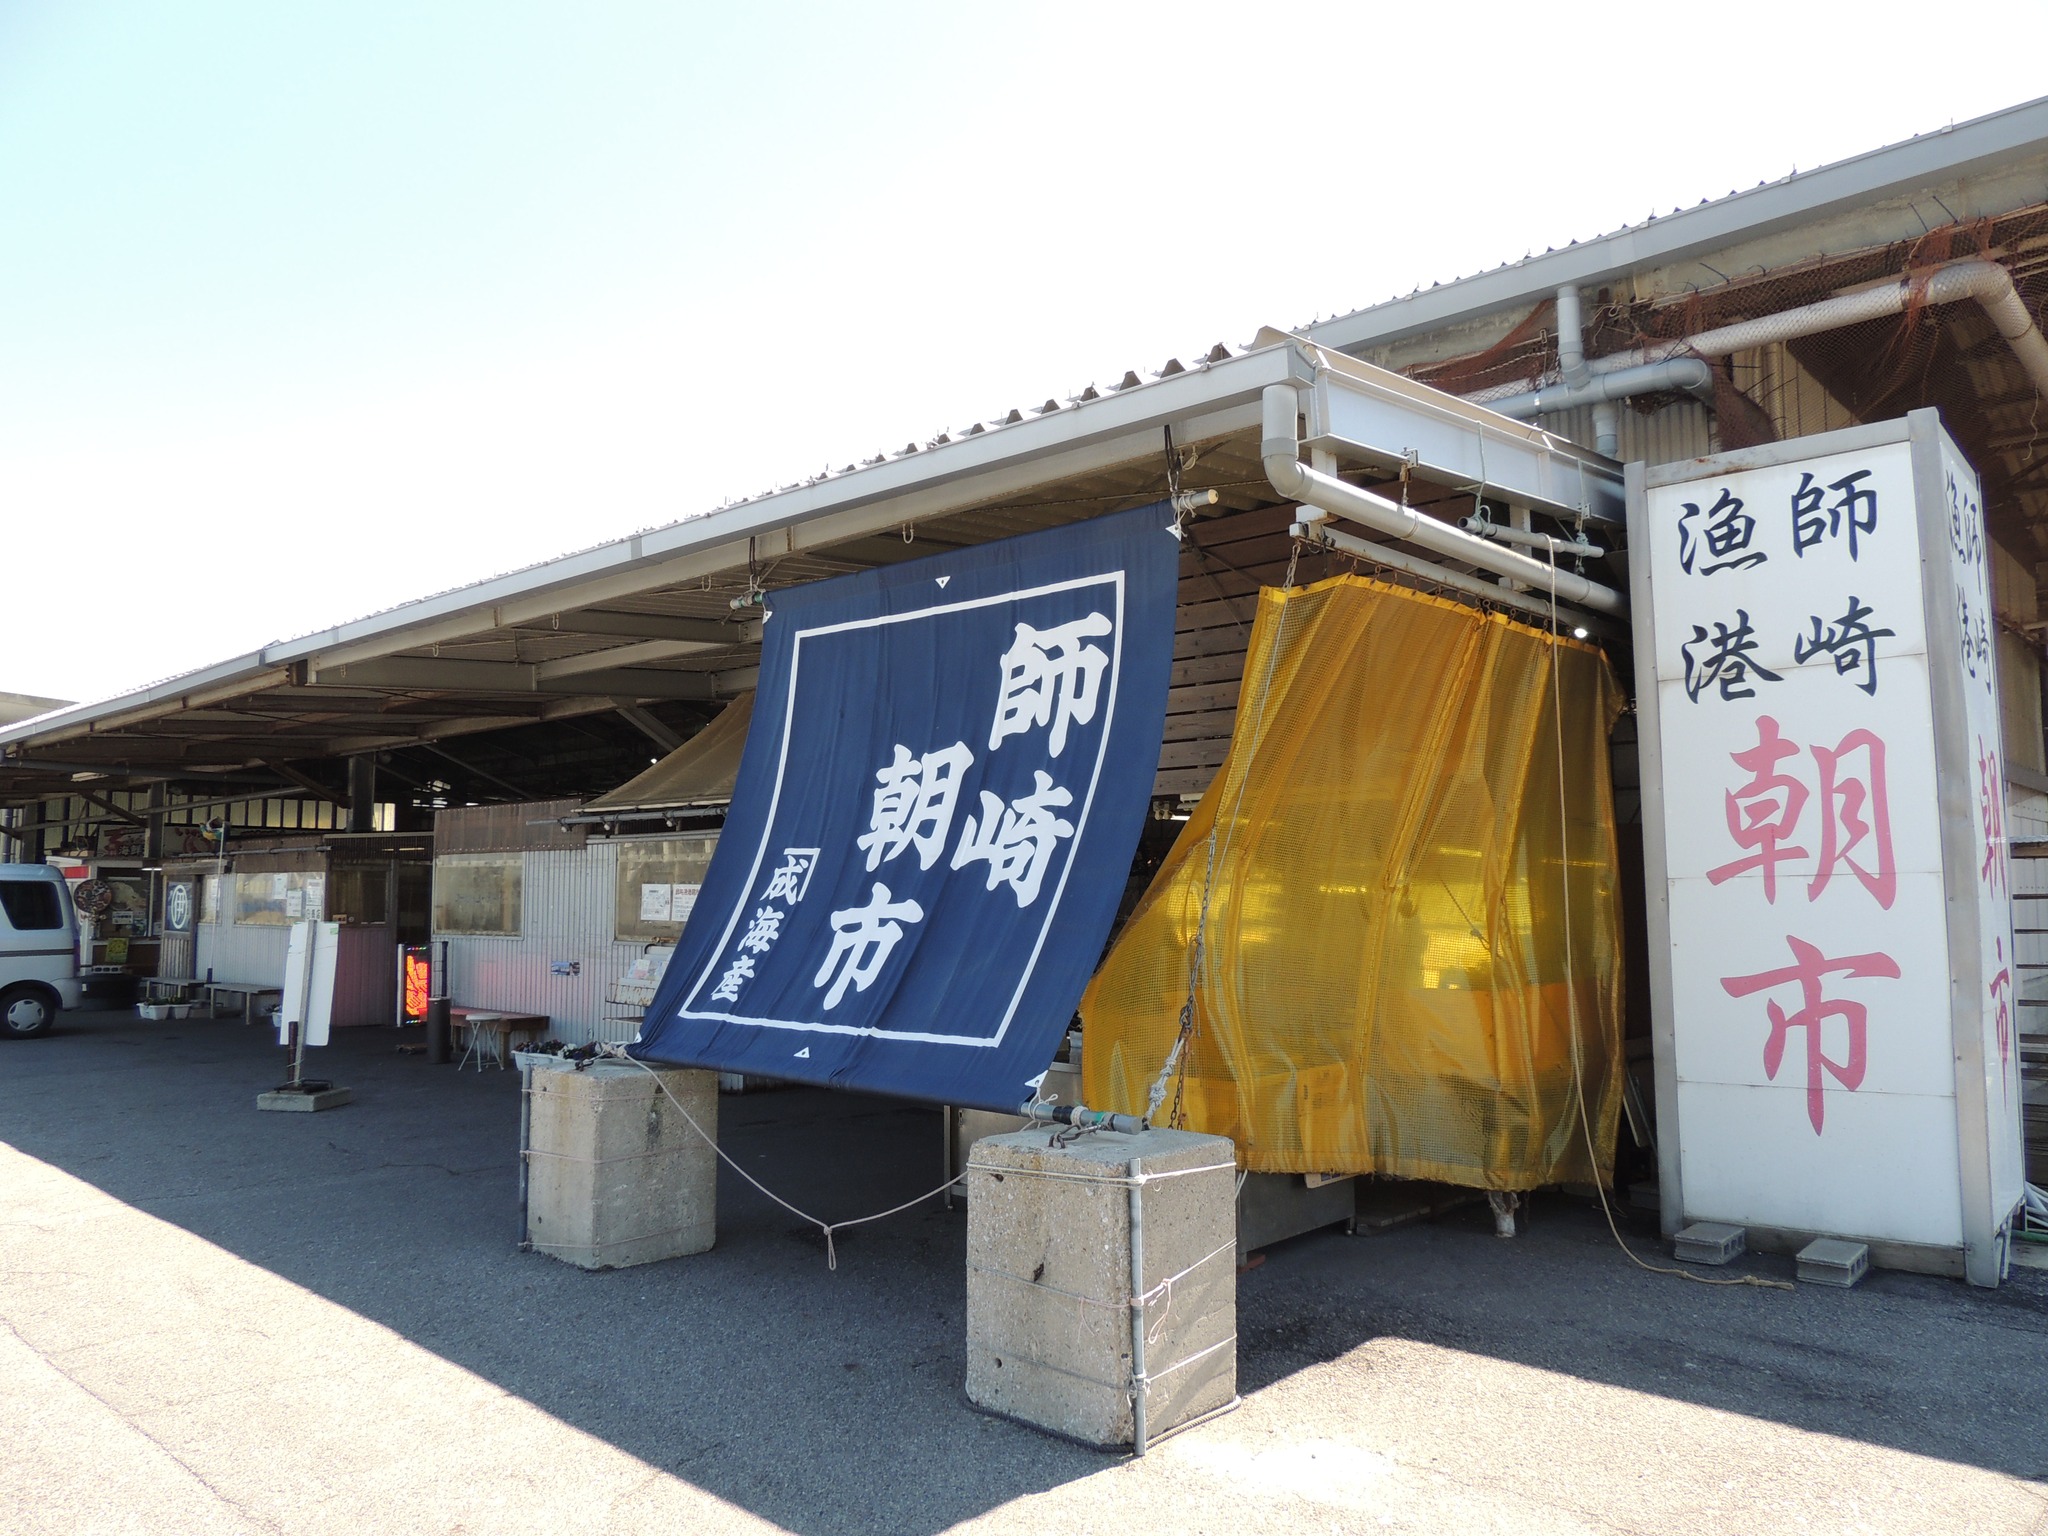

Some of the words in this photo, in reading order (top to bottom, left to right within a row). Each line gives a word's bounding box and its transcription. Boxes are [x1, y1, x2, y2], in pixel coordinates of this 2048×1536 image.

[1676, 487, 1785, 705] 漁港
[1793, 469, 1895, 698] 師崎
[813, 740, 974, 1011] 朝市
[951, 611, 1112, 908] 師崎
[711, 854, 810, 1002] 成海産
[1705, 714, 1901, 1138] 朝市
[1977, 733, 2010, 1112] 朝市
